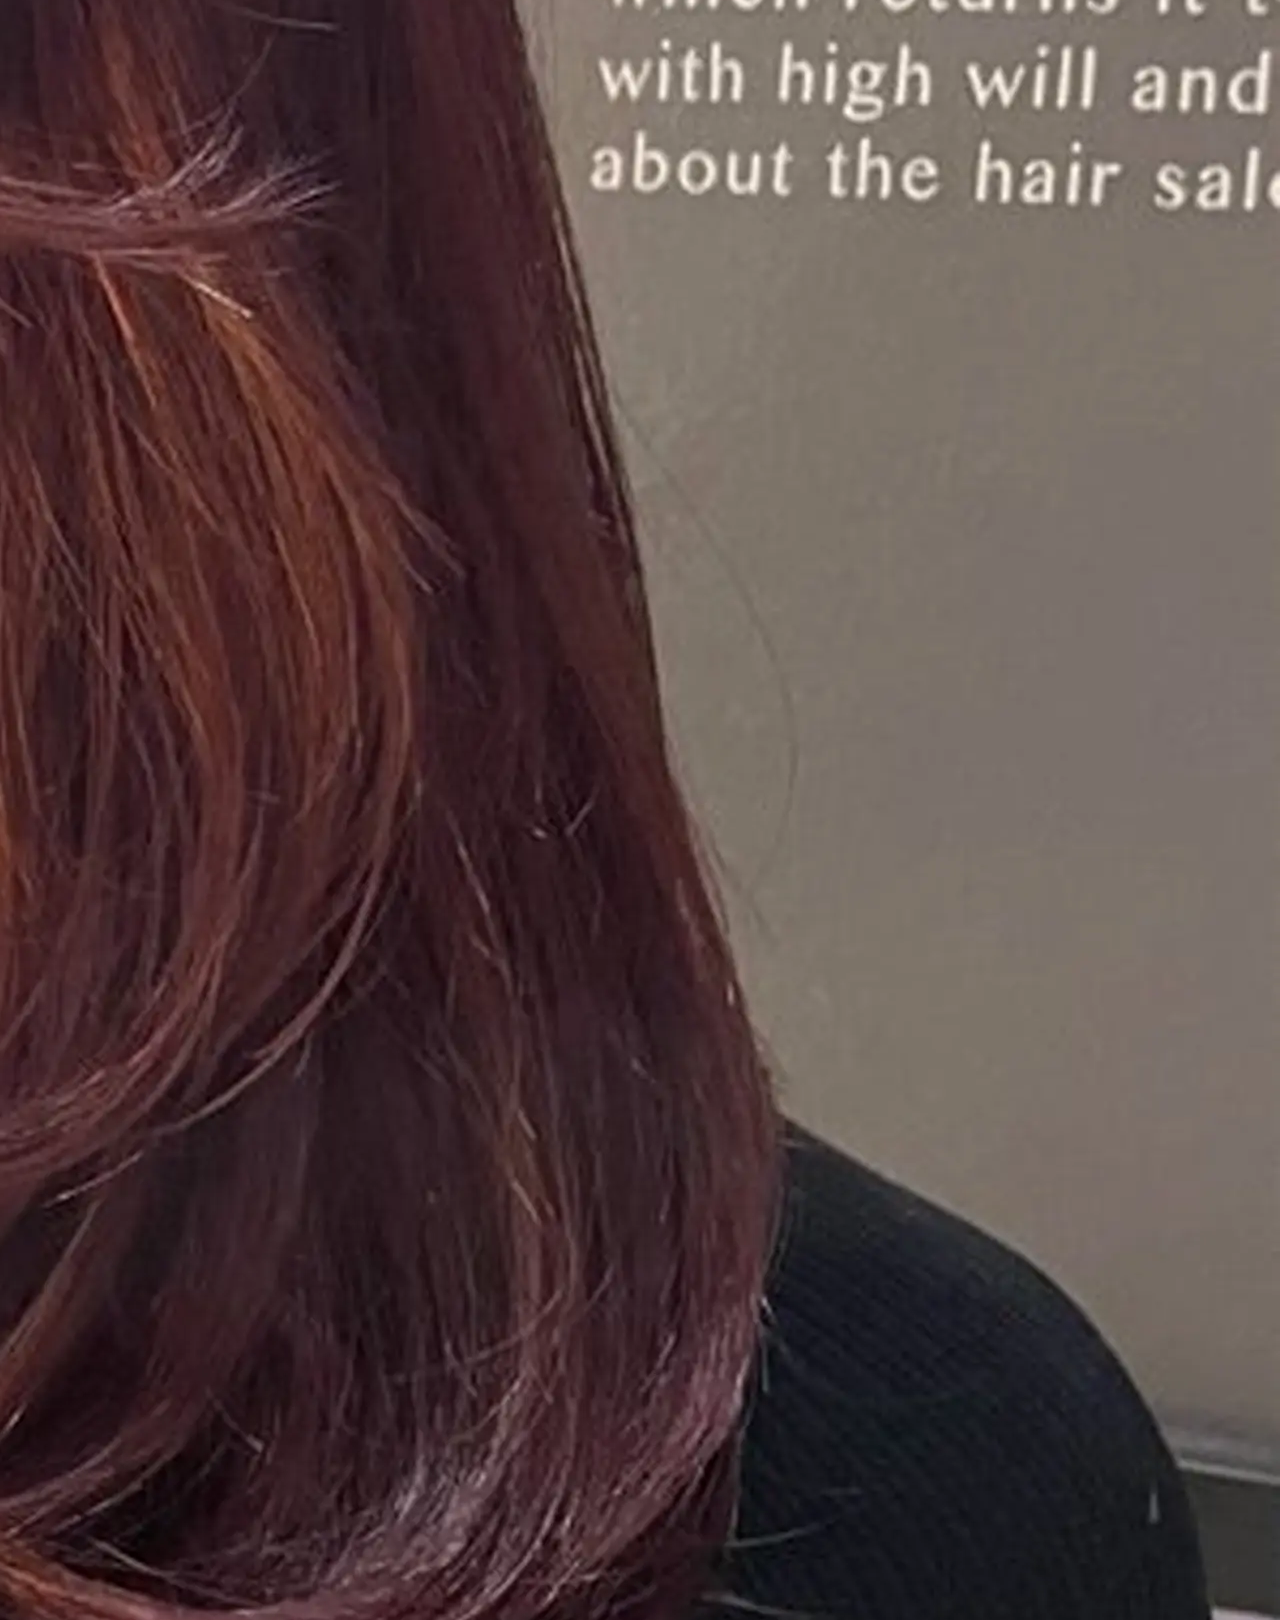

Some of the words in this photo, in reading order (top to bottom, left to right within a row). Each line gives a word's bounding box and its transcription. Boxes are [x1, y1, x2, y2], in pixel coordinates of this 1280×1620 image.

[598, 36, 744, 103] with
[777, 41, 933, 122] high
[965, 45, 1097, 110] will
[1130, 48, 1272, 115] and
[589, 132, 795, 198] about
[826, 138, 939, 201] the
[974, 139, 1122, 206] hair
[1153, 146, 1280, 211] sal
